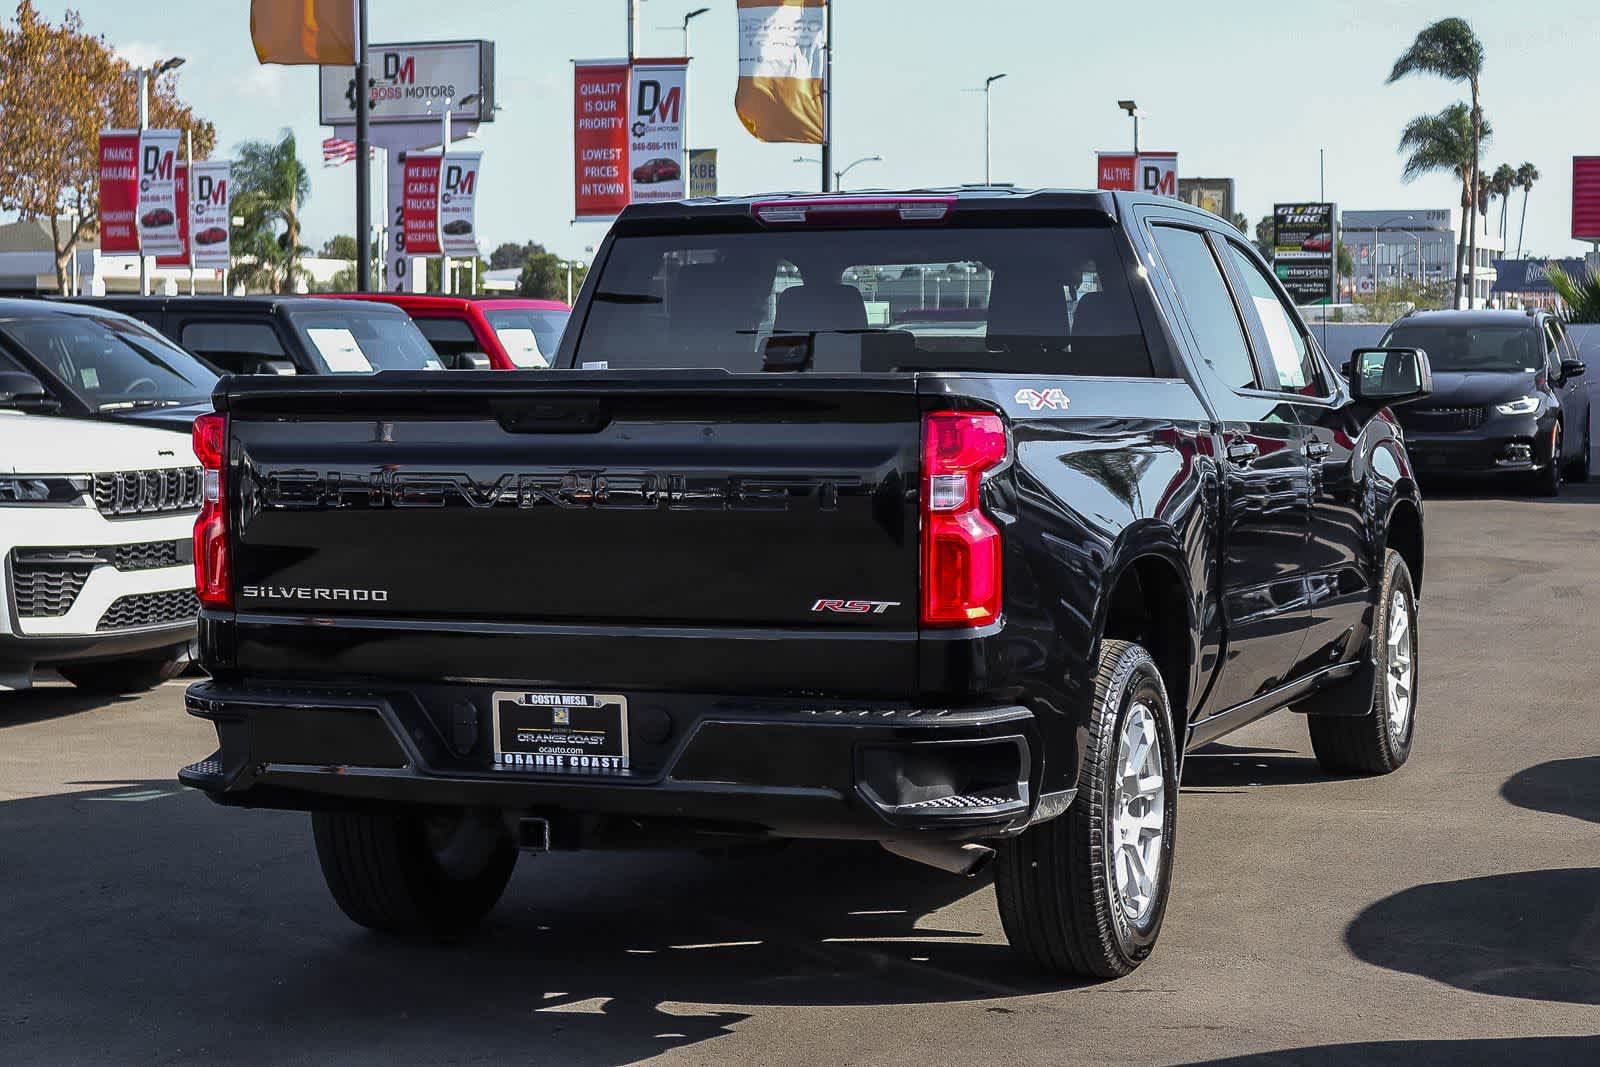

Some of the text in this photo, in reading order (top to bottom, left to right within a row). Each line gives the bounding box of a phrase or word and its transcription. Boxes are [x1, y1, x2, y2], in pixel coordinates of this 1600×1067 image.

[406, 85, 456, 98] MOTORS
[580, 83, 622, 96] QUALITY
[584, 100, 617, 112] IS OUR
[579, 117, 624, 129] PRIORITY
[104, 148, 132, 161] FINANCE
[582, 148, 622, 161] LOWEST
[408, 167, 438, 177] WE BUY
[585, 166, 619, 177] PRICES
[690, 164, 716, 178] KBB
[1103, 168, 1131, 180] ALL TYPE
[408, 183, 429, 193] CARS
[581, 183, 624, 194] IN TOWN
[407, 200, 435, 209] TRUCKS
[1286, 215, 1321, 223] TIRE
[811, 598, 901, 614] RST
[531, 694, 588, 706] COSTA MESA
[517, 733, 605, 745] ORANGE COAST
[538, 746, 584, 755] ocauto.com
[504, 753, 620, 769] ORANGE COAST
